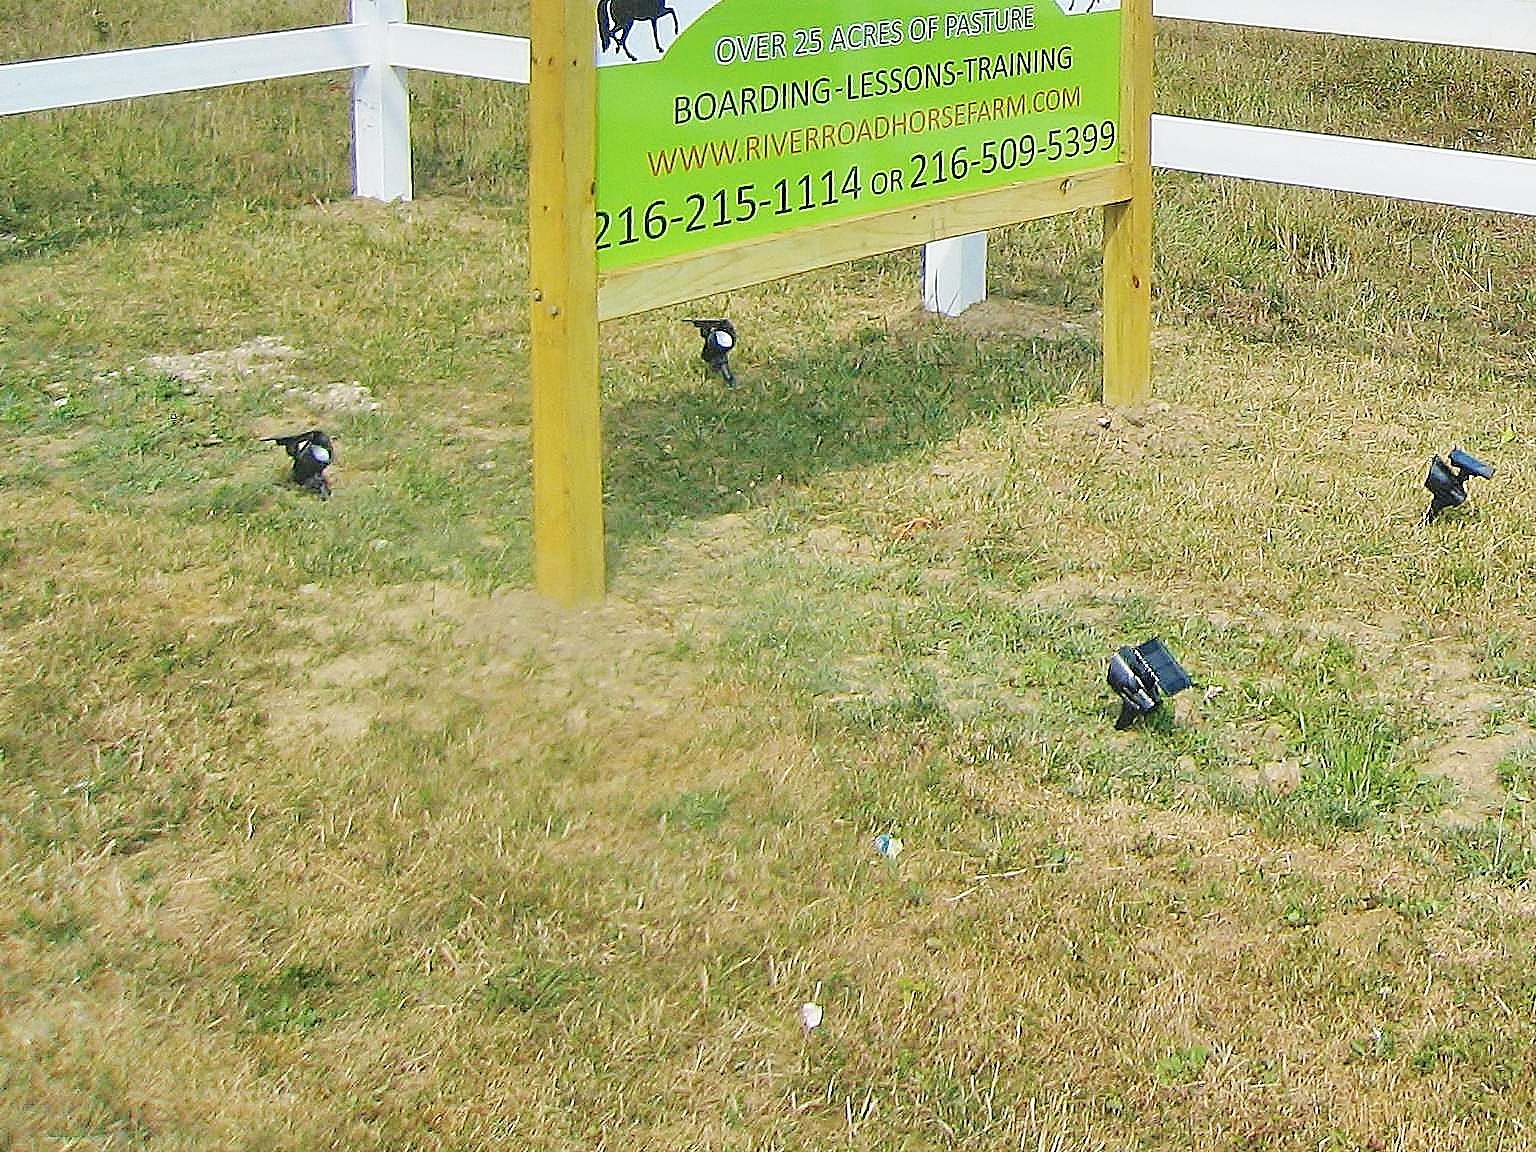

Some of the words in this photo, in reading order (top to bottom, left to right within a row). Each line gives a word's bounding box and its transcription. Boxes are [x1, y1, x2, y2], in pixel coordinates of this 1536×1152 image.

[714, 33, 787, 66] OVER
[794, 26, 823, 57] 25
[829, 20, 902, 51] ACRES
[909, 14, 939, 43] OF
[944, 6, 1035, 36] PASTURE
[646, 86, 1082, 177] WWW.RIVERROADHORSEFARM.COM
[596, 165, 863, 250] 216-215-1114
[870, 170, 904, 196] OR
[910, 119, 1116, 189] 216-509-5399
